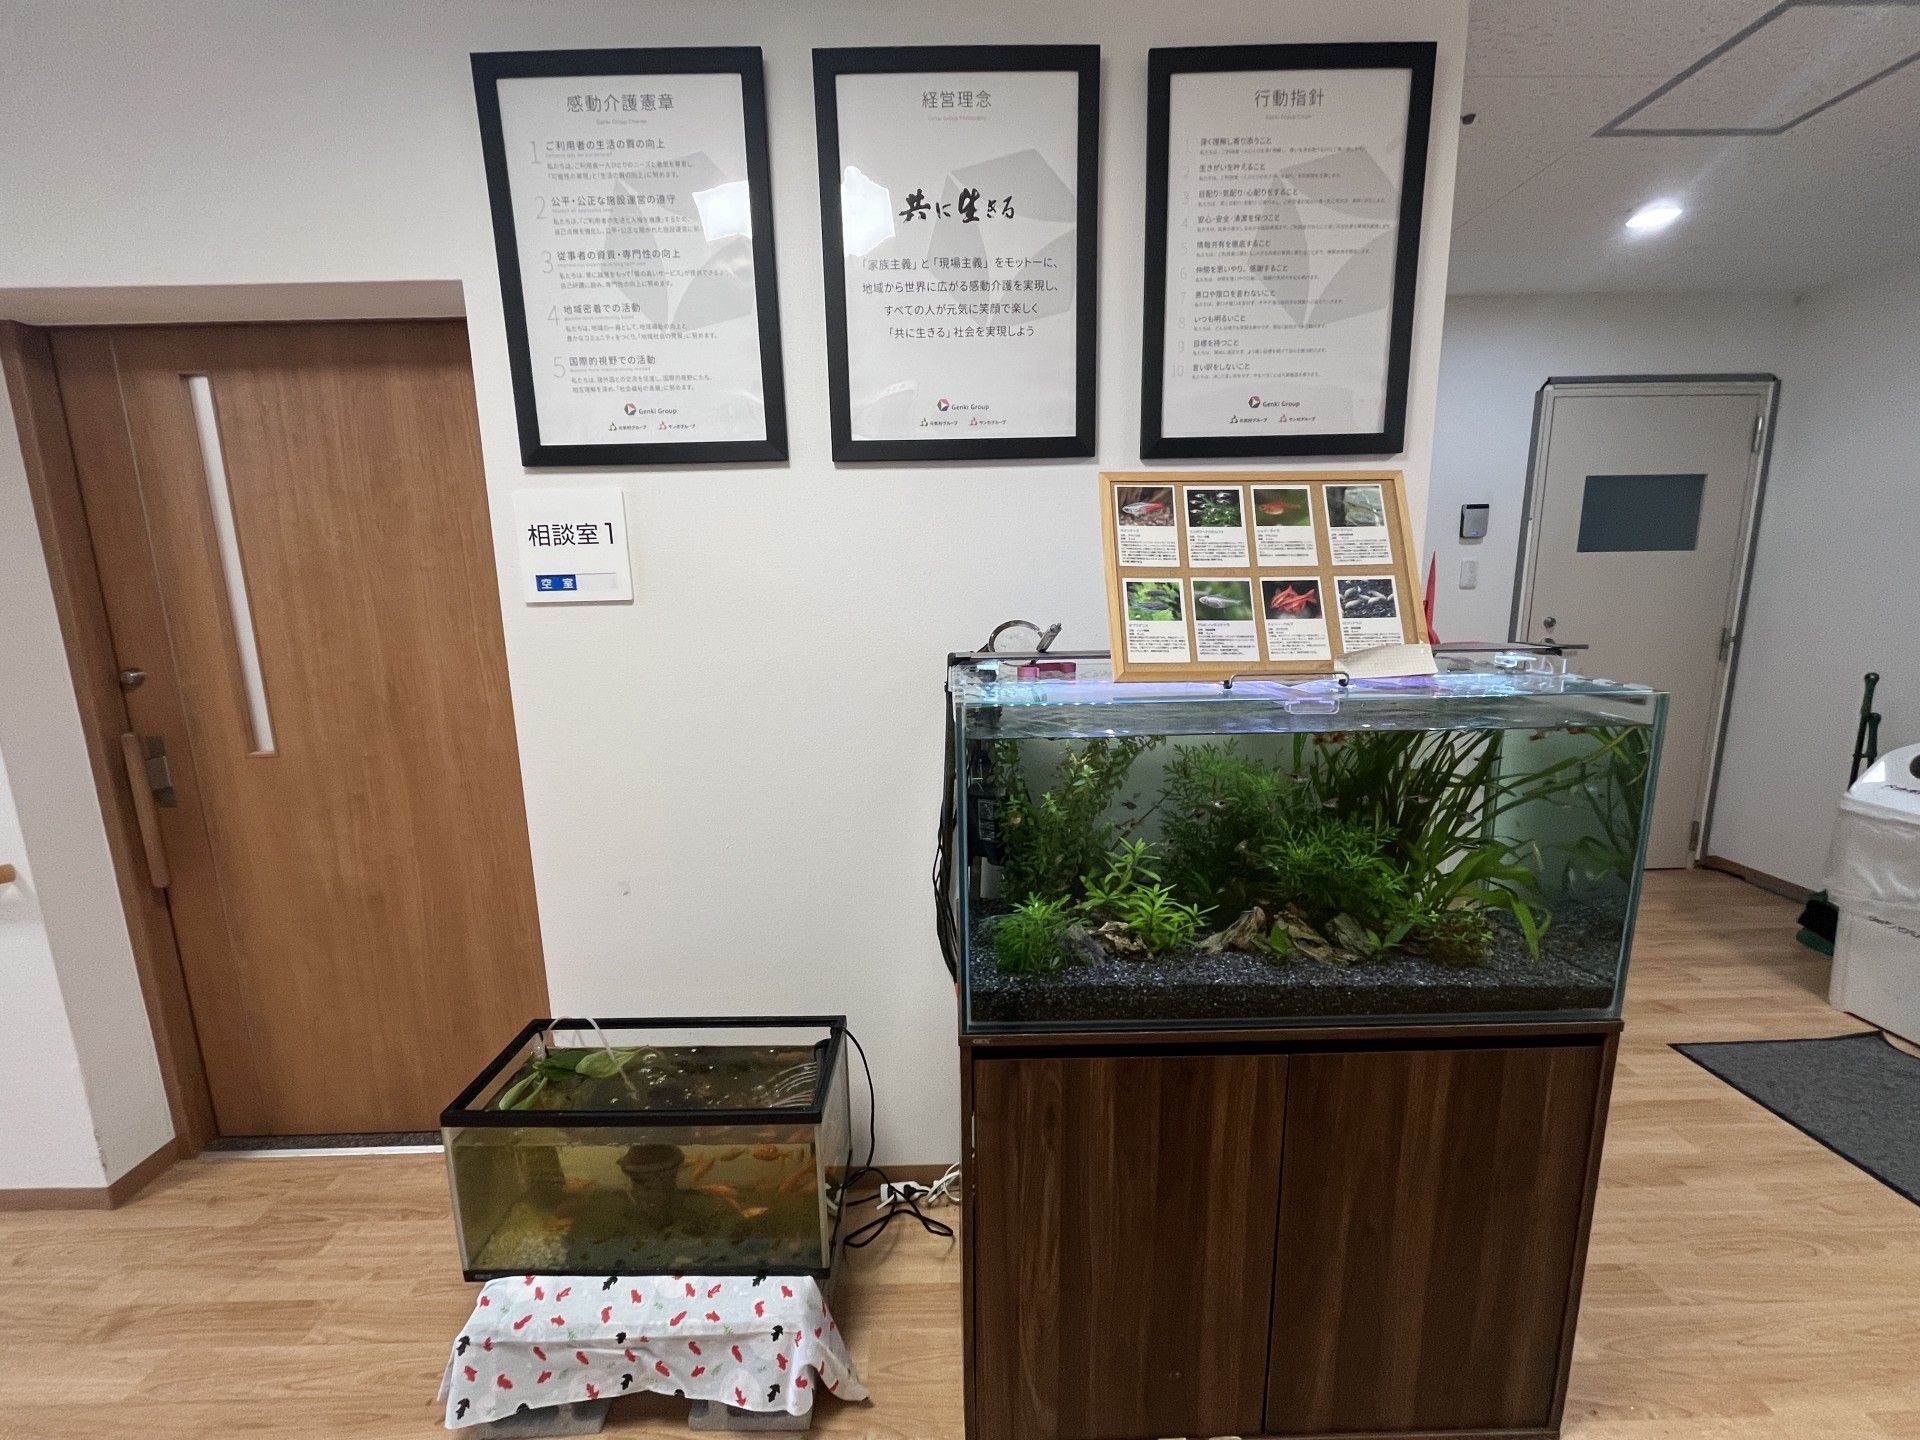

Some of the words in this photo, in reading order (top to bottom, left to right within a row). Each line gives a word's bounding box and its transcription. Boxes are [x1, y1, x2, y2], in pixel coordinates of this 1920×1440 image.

[567, 93, 675, 112] 感動介護憲章
[922, 90, 992, 109] 経営理念
[1255, 88, 1324, 107] 行動指針
[530, 141, 540, 164] 1
[546, 138, 665, 151] ご利用者の生活の質の向上
[535, 195, 547, 219] 2
[552, 194, 676, 206] 公平・公正な施設運営の遵守
[899, 188, 1015, 223] 共に生きる
[557, 249, 681, 261] 従事者の資質・専門性の向上
[862, 257, 1058, 271] 「家族主義」と「現場主義」をモットーに、
[862, 279, 1058, 294] 地域から世界に広がる感動介護を実現し、
[547, 305, 560, 326] 4
[563, 303, 640, 314] 地域密着での活動
[884, 303, 1038, 316] すべての人が元気に笑顔で楽しく
[1195, 314, 1246, 323] いつも明るいこと
[888, 325, 1035, 339] 「共に生きる」社会を実現しよう
[1193, 338, 1239, 347] 目標を持つこと
[553, 356, 566, 379] 5
[569, 355, 656, 367] 国際的視野での活動
[1193, 362, 1250, 371] 言い訳をしないこと
[970, 403, 989, 412] Group
[1281, 400, 1300, 408] Group
[638, 408, 656, 416] Genki
[658, 408, 677, 416] Group
